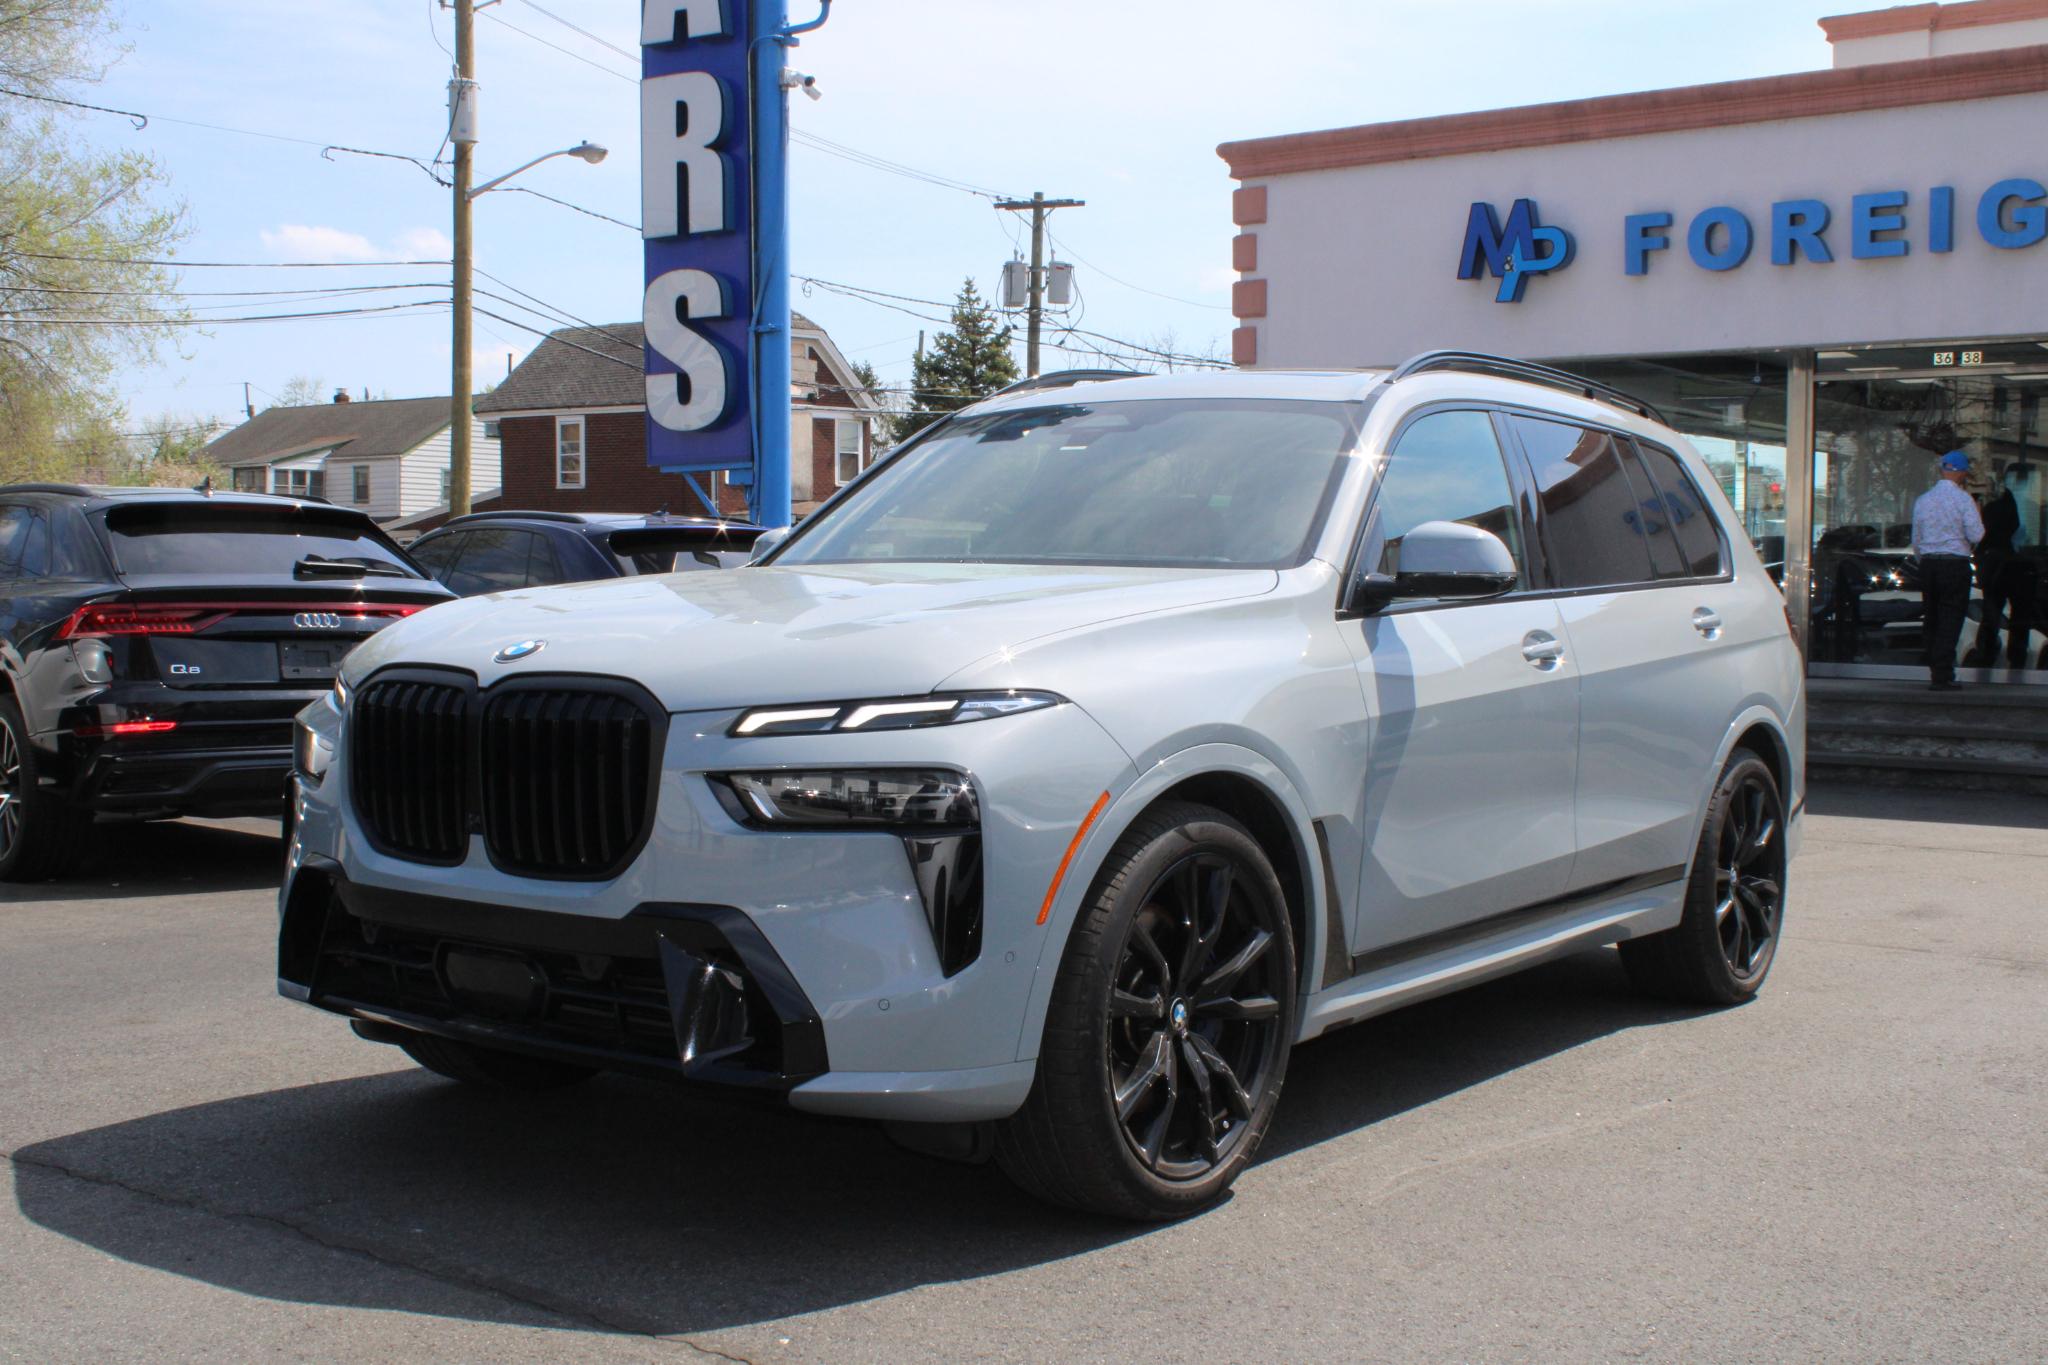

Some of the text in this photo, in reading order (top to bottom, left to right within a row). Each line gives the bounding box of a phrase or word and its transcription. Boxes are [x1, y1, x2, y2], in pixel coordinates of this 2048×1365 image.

[641, 0, 728, 432] RS
[1625, 178, 2048, 276] FOREIG
[1935, 352, 1980, 364] 36 38
[171, 664, 201, 674] Q8
